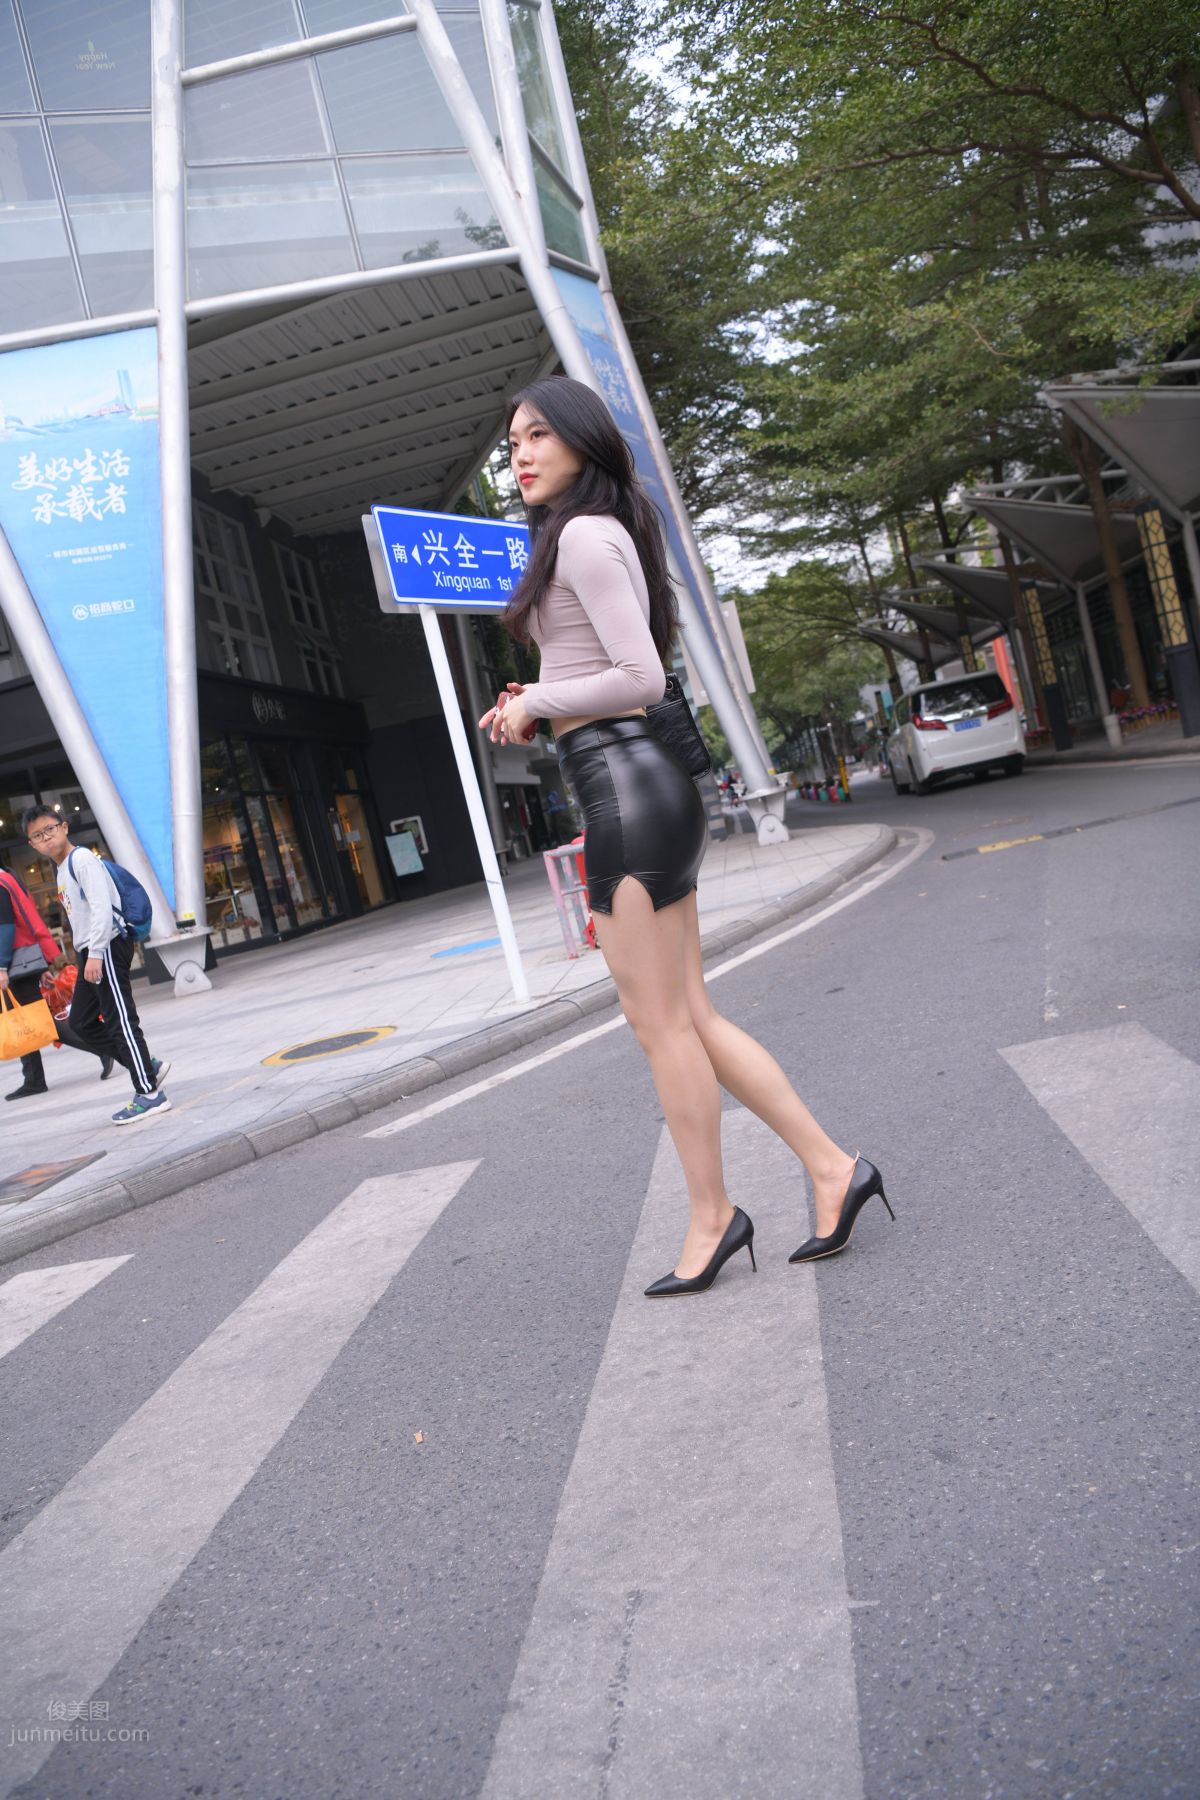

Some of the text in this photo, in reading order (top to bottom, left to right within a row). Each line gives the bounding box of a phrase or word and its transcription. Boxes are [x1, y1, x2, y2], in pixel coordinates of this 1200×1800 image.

[11, 447, 131, 491] 美好生活
[391, 529, 529, 571] 南 兴全一路
[432, 570, 513, 592] Xingquan 1st
